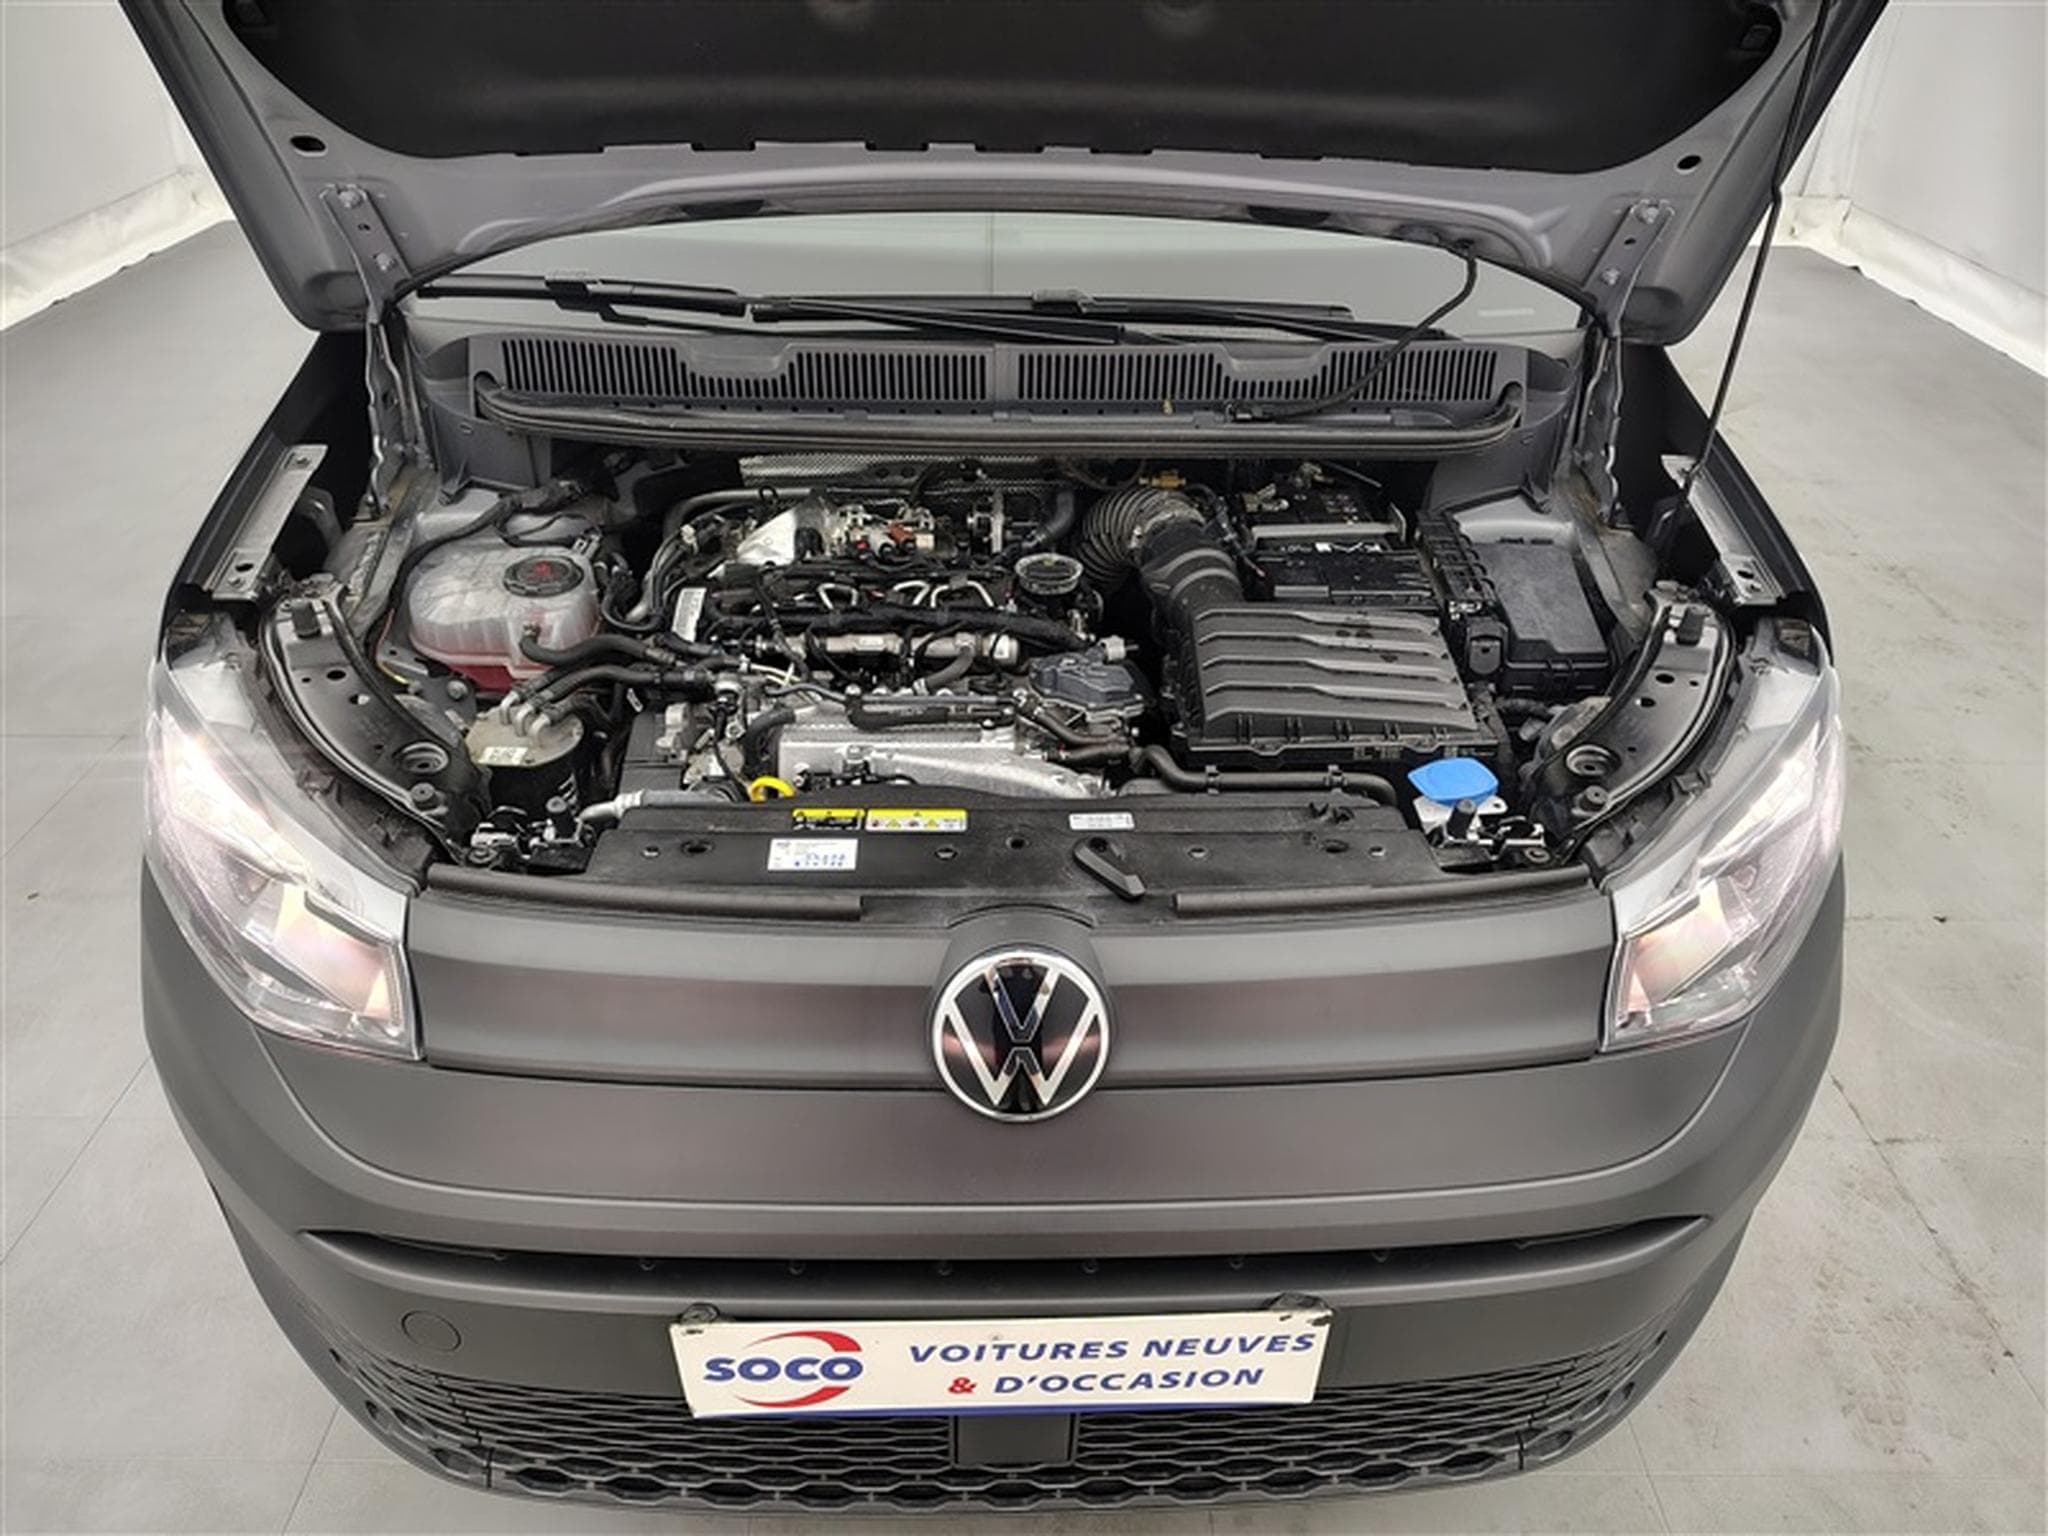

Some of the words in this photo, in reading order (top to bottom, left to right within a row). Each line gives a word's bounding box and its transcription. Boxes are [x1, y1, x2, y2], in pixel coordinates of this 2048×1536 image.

[933, 950, 1110, 1121] VW
[909, 1340, 1127, 1363] VOITURES
[1143, 1333, 1315, 1357] NEUVES
[704, 1356, 864, 1382] SOCO
[947, 1377, 977, 1395] &
[994, 1367, 1265, 1394] D'OCCASION
